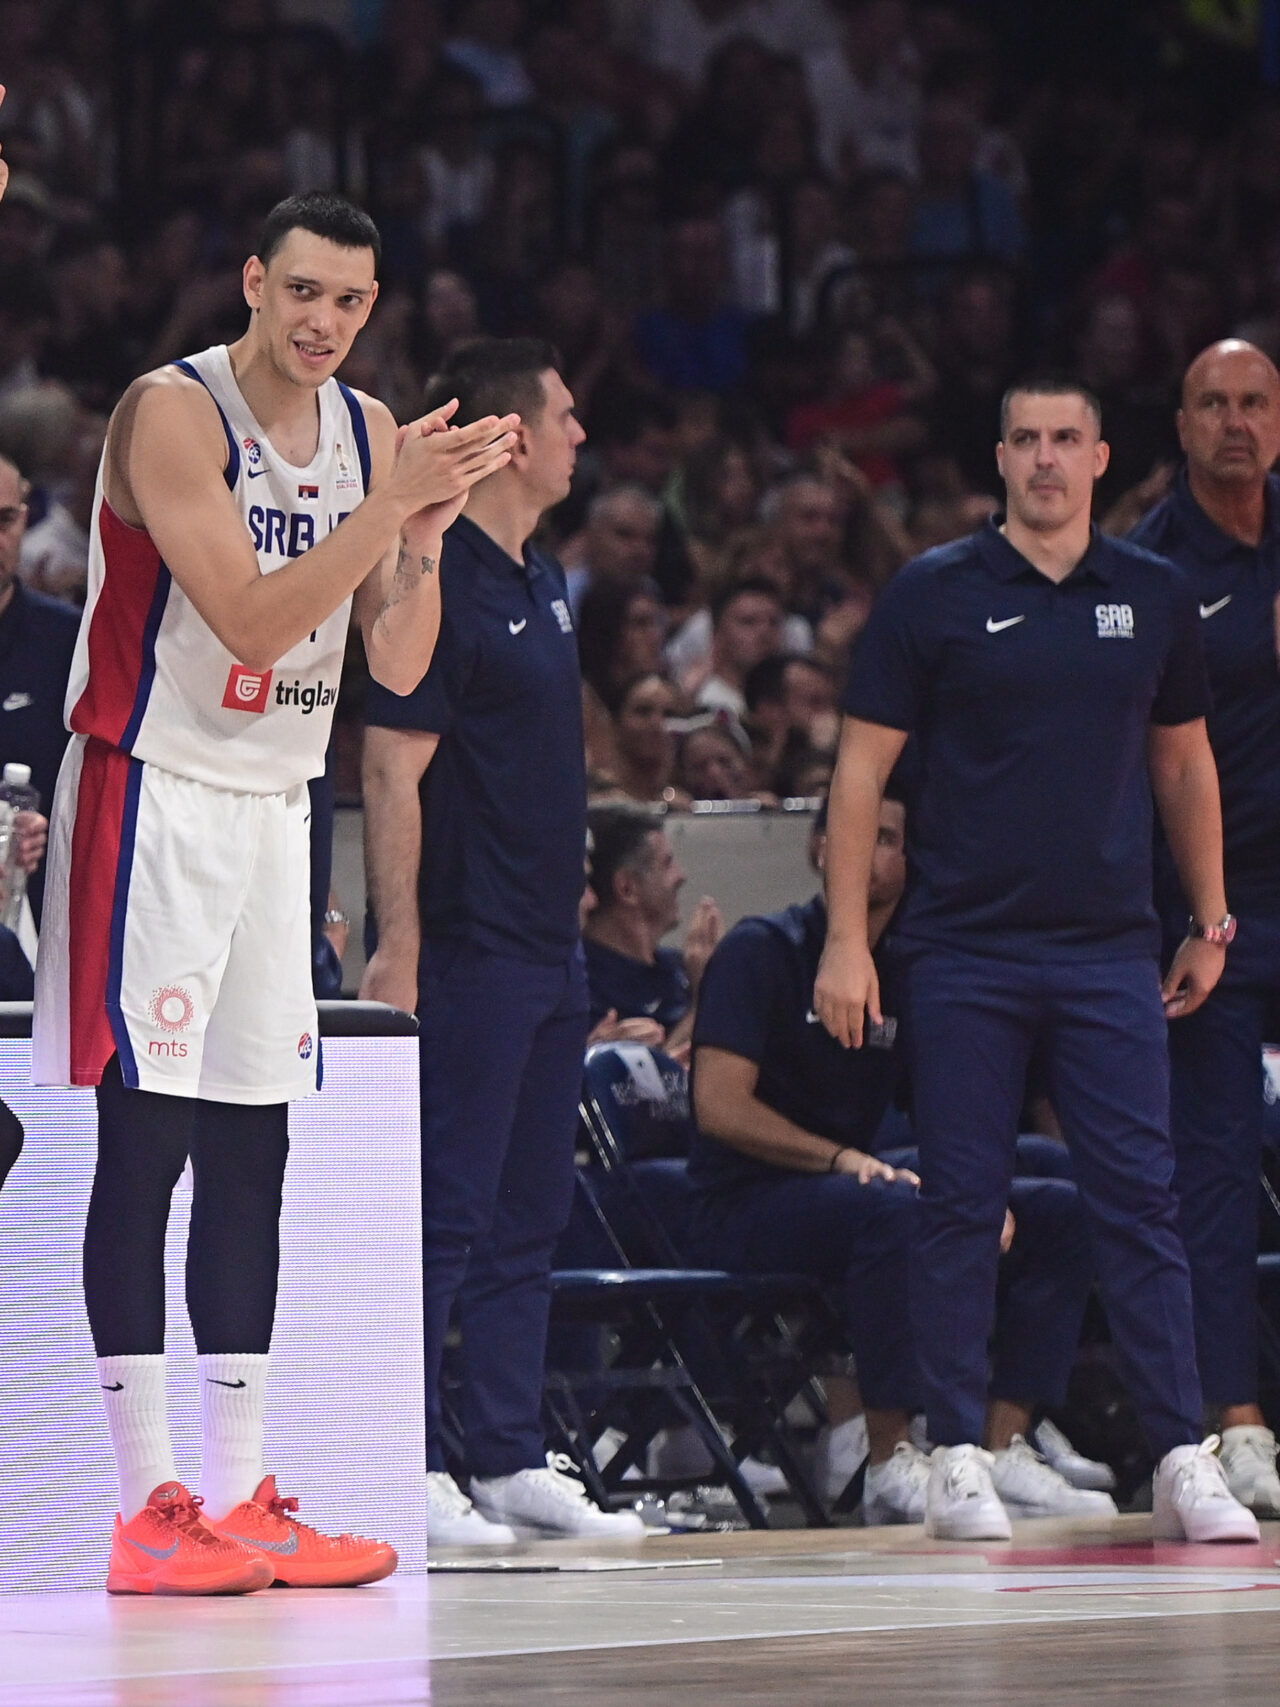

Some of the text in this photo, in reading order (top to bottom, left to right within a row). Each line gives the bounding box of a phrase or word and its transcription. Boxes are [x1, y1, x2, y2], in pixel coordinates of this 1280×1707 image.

[249, 505, 352, 558] SRB
[1095, 603, 1134, 629] SRB
[275, 680, 337, 715] triglav
[148, 1039, 188, 1058] mts
